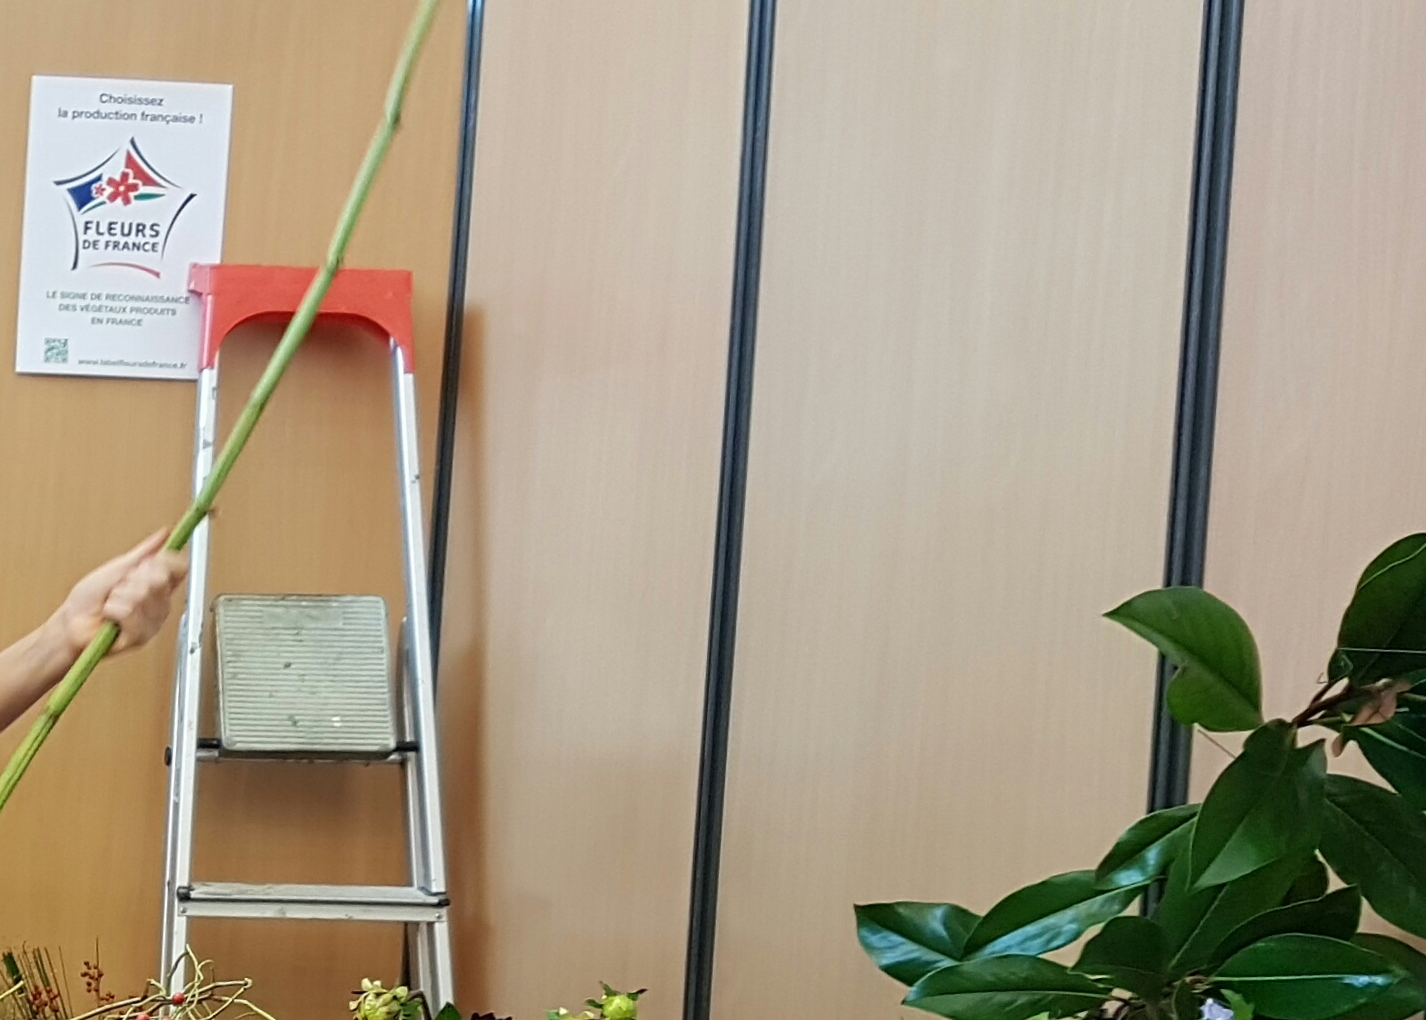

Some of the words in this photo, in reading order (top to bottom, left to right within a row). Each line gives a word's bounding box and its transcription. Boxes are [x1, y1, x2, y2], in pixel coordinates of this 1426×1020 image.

[99, 93, 164, 106] Choisissez
[58, 107, 68, 118] la
[71, 109, 137, 120] production
[140, 110, 196, 125] française
[83, 220, 160, 238] FLEURS
[82, 239, 100, 250] DE
[104, 240, 159, 252] FRANCE
[46, 290, 57, 299] LE
[60, 291, 87, 300] SIGNE
[90, 292, 102, 300] DE
[105, 292, 190, 304] RECONNAISSANCE
[58, 303, 77, 312] DES
[130, 306, 177, 316] PRODUITS
[91, 317, 103, 325] EN
[106, 318, 143, 327] FRANCE
